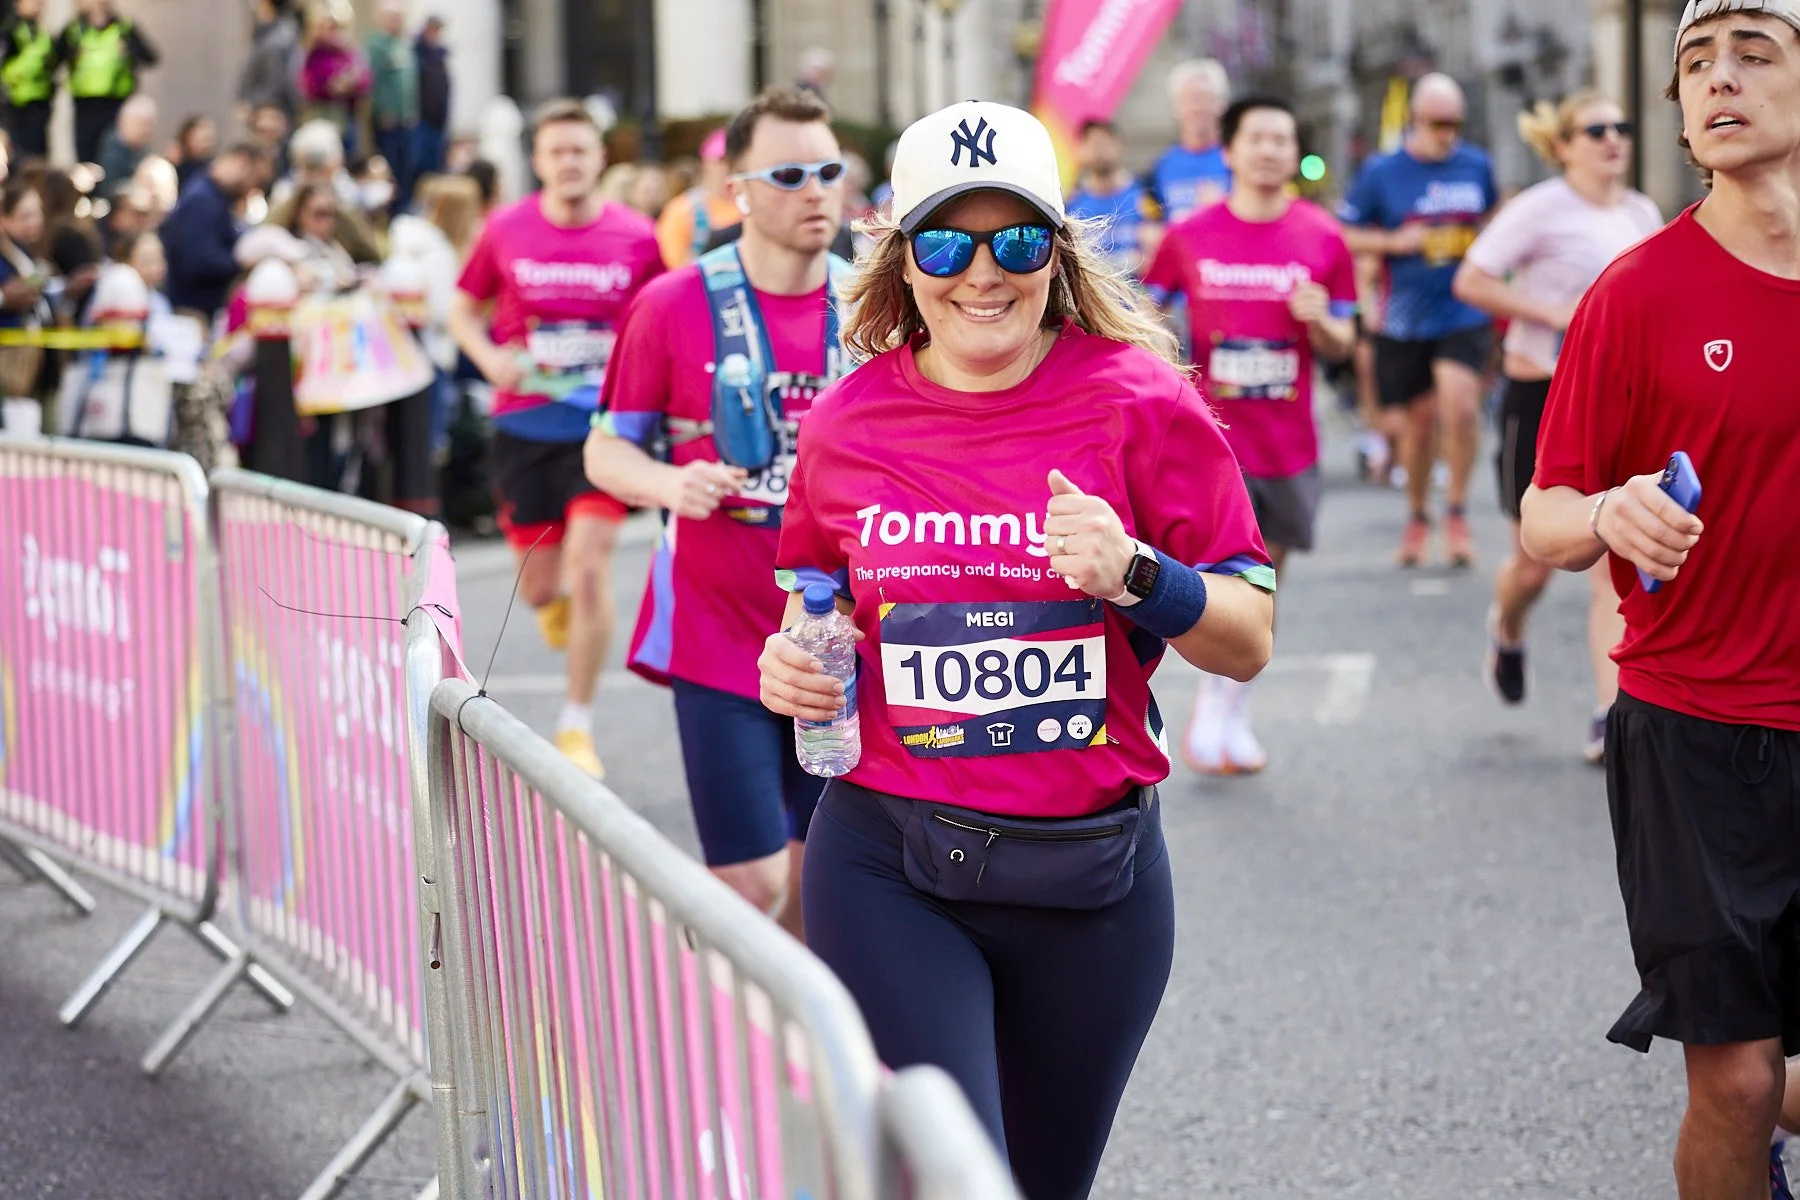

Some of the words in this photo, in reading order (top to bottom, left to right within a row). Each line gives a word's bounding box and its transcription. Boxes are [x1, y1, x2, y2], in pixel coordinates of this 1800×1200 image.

[949, 116, 998, 168] NY
[855, 566, 874, 581] The
[876, 565, 960, 582] pregnancy
[965, 562, 995, 577] and
[999, 563, 1041, 582] baby
[966, 611, 1014, 627] MEGI
[901, 644, 1092, 702] 10804
[904, 733, 929, 745] LONDON
[1076, 726, 1084, 735] 4
